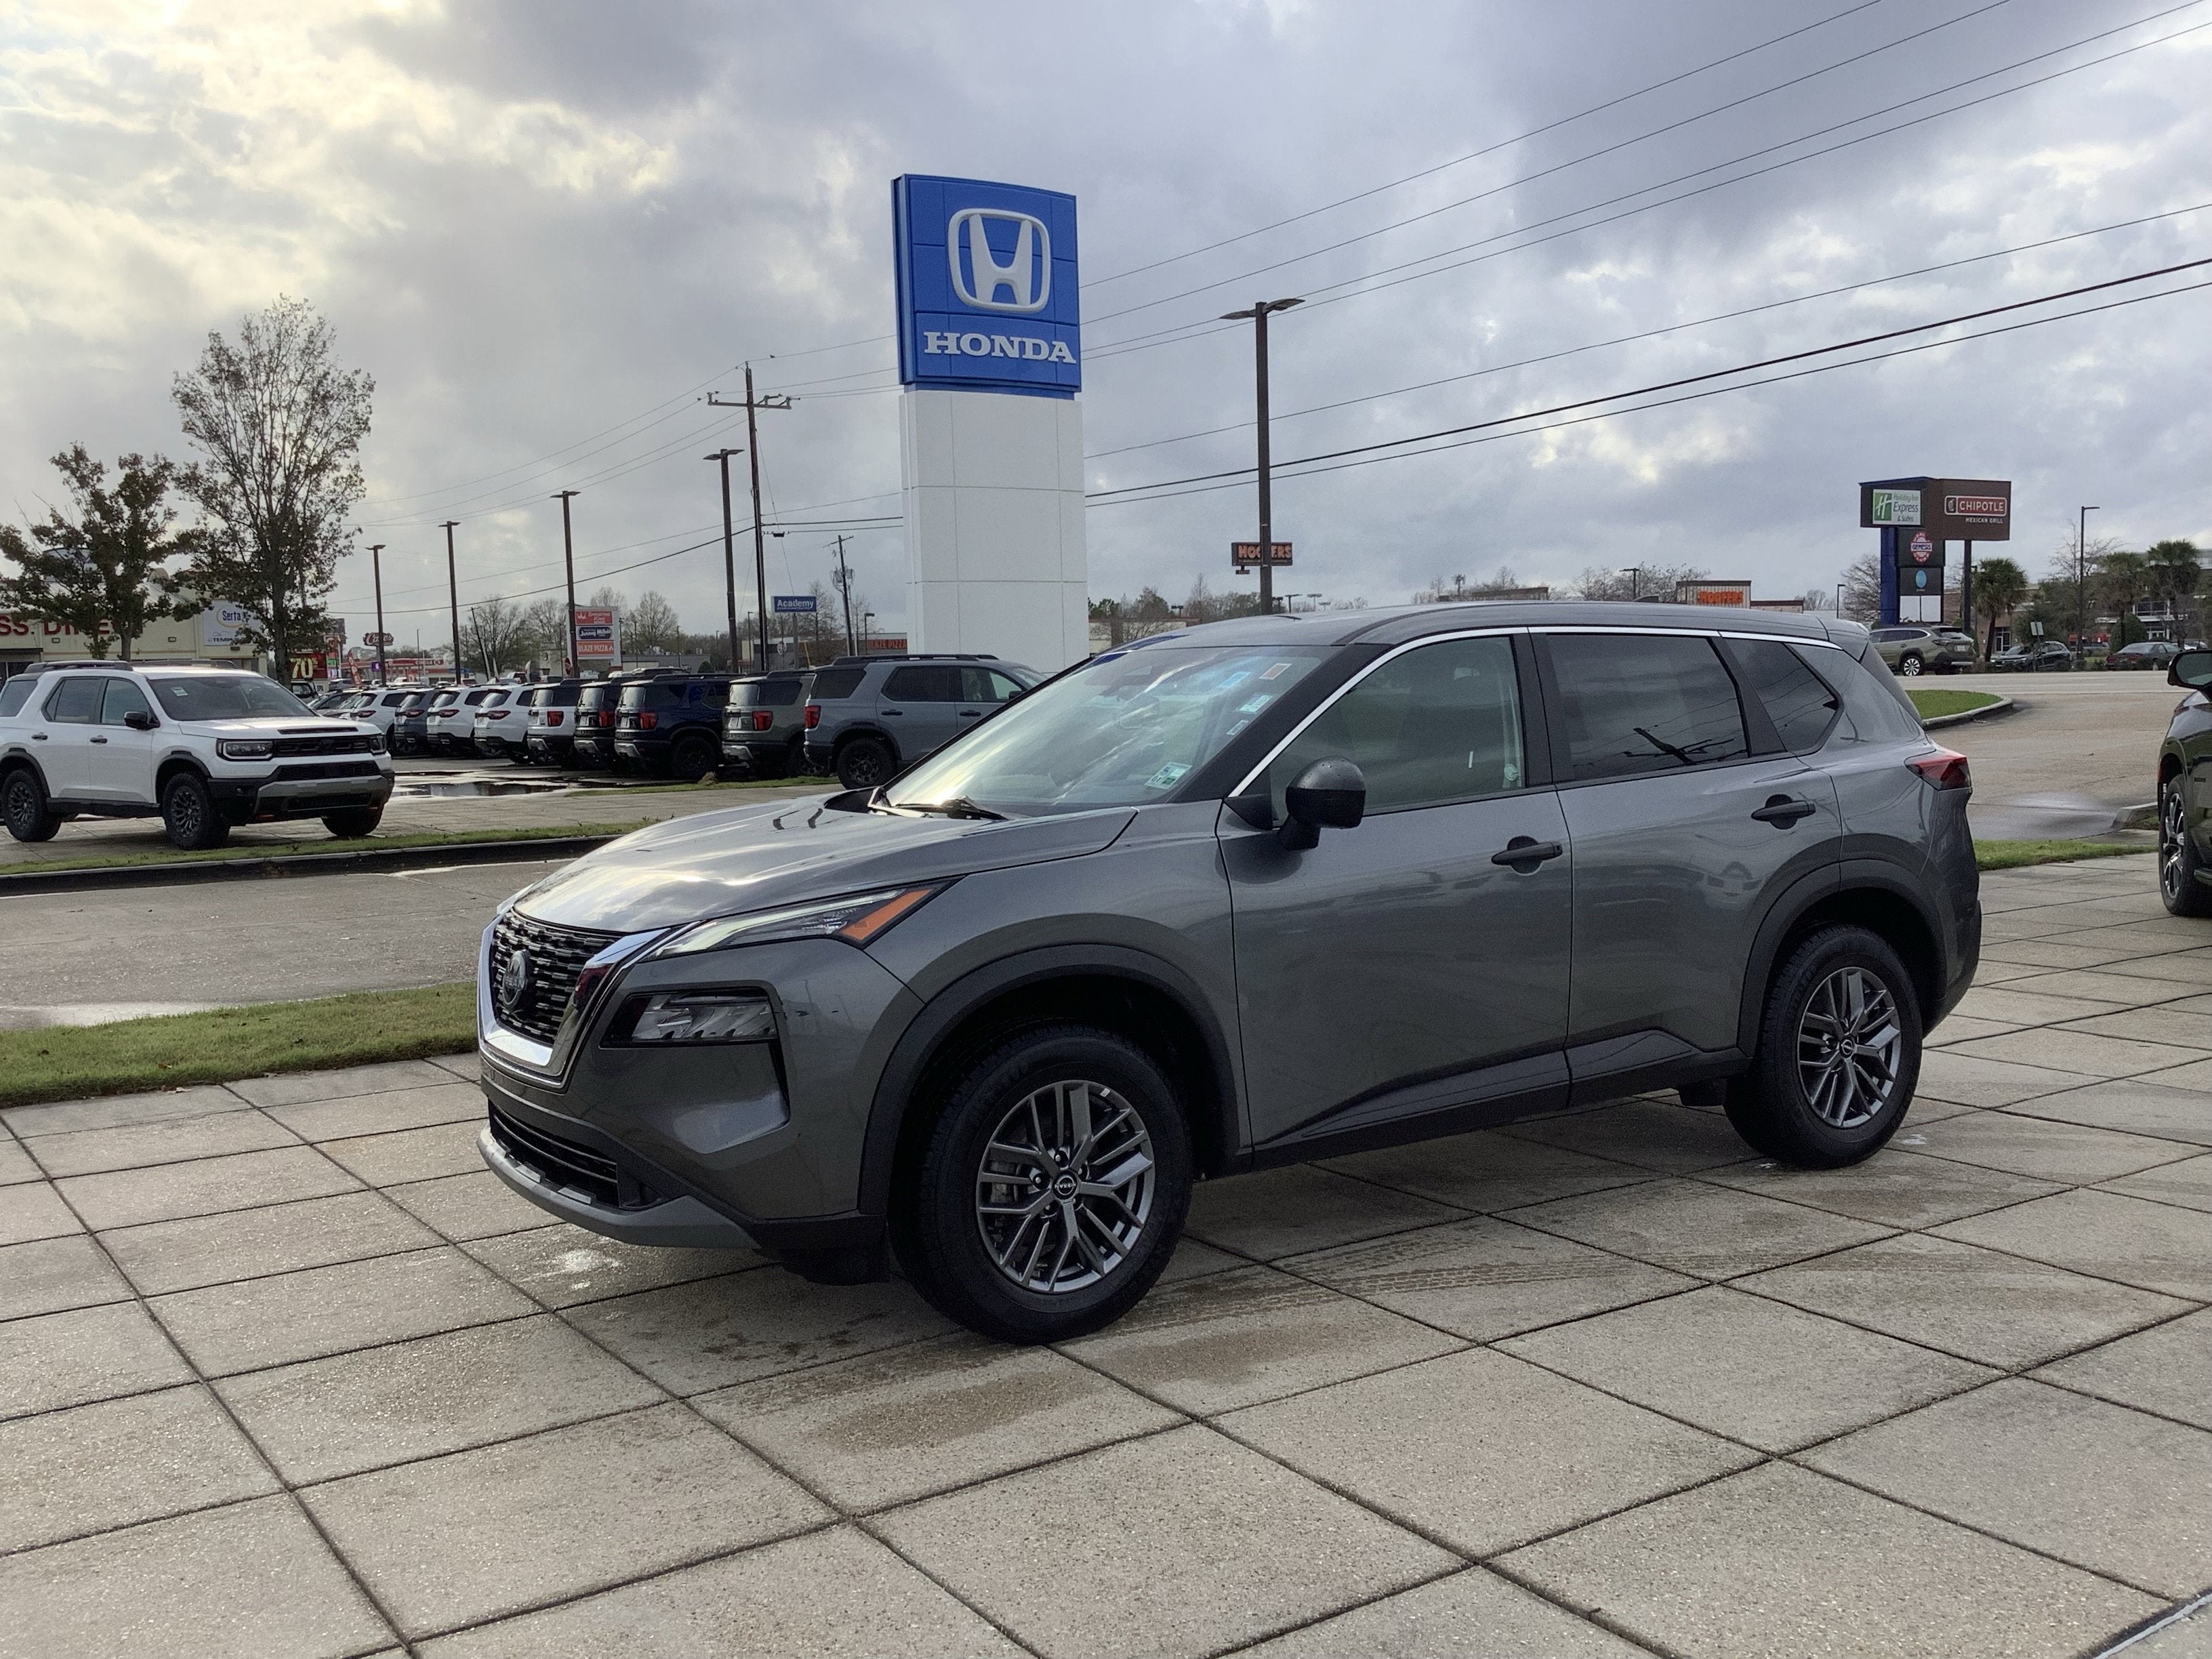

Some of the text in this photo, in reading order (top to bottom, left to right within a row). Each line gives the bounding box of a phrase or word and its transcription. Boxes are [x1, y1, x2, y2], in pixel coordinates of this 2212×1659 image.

[924, 332, 1076, 363] HONDA
[1893, 501, 1919, 514] Express
[1959, 501, 2004, 512] CHIPOTLE
[1238, 545, 1292, 558] HOERS
[777, 599, 813, 609] Academy
[222, 610, 241, 621] Serta
